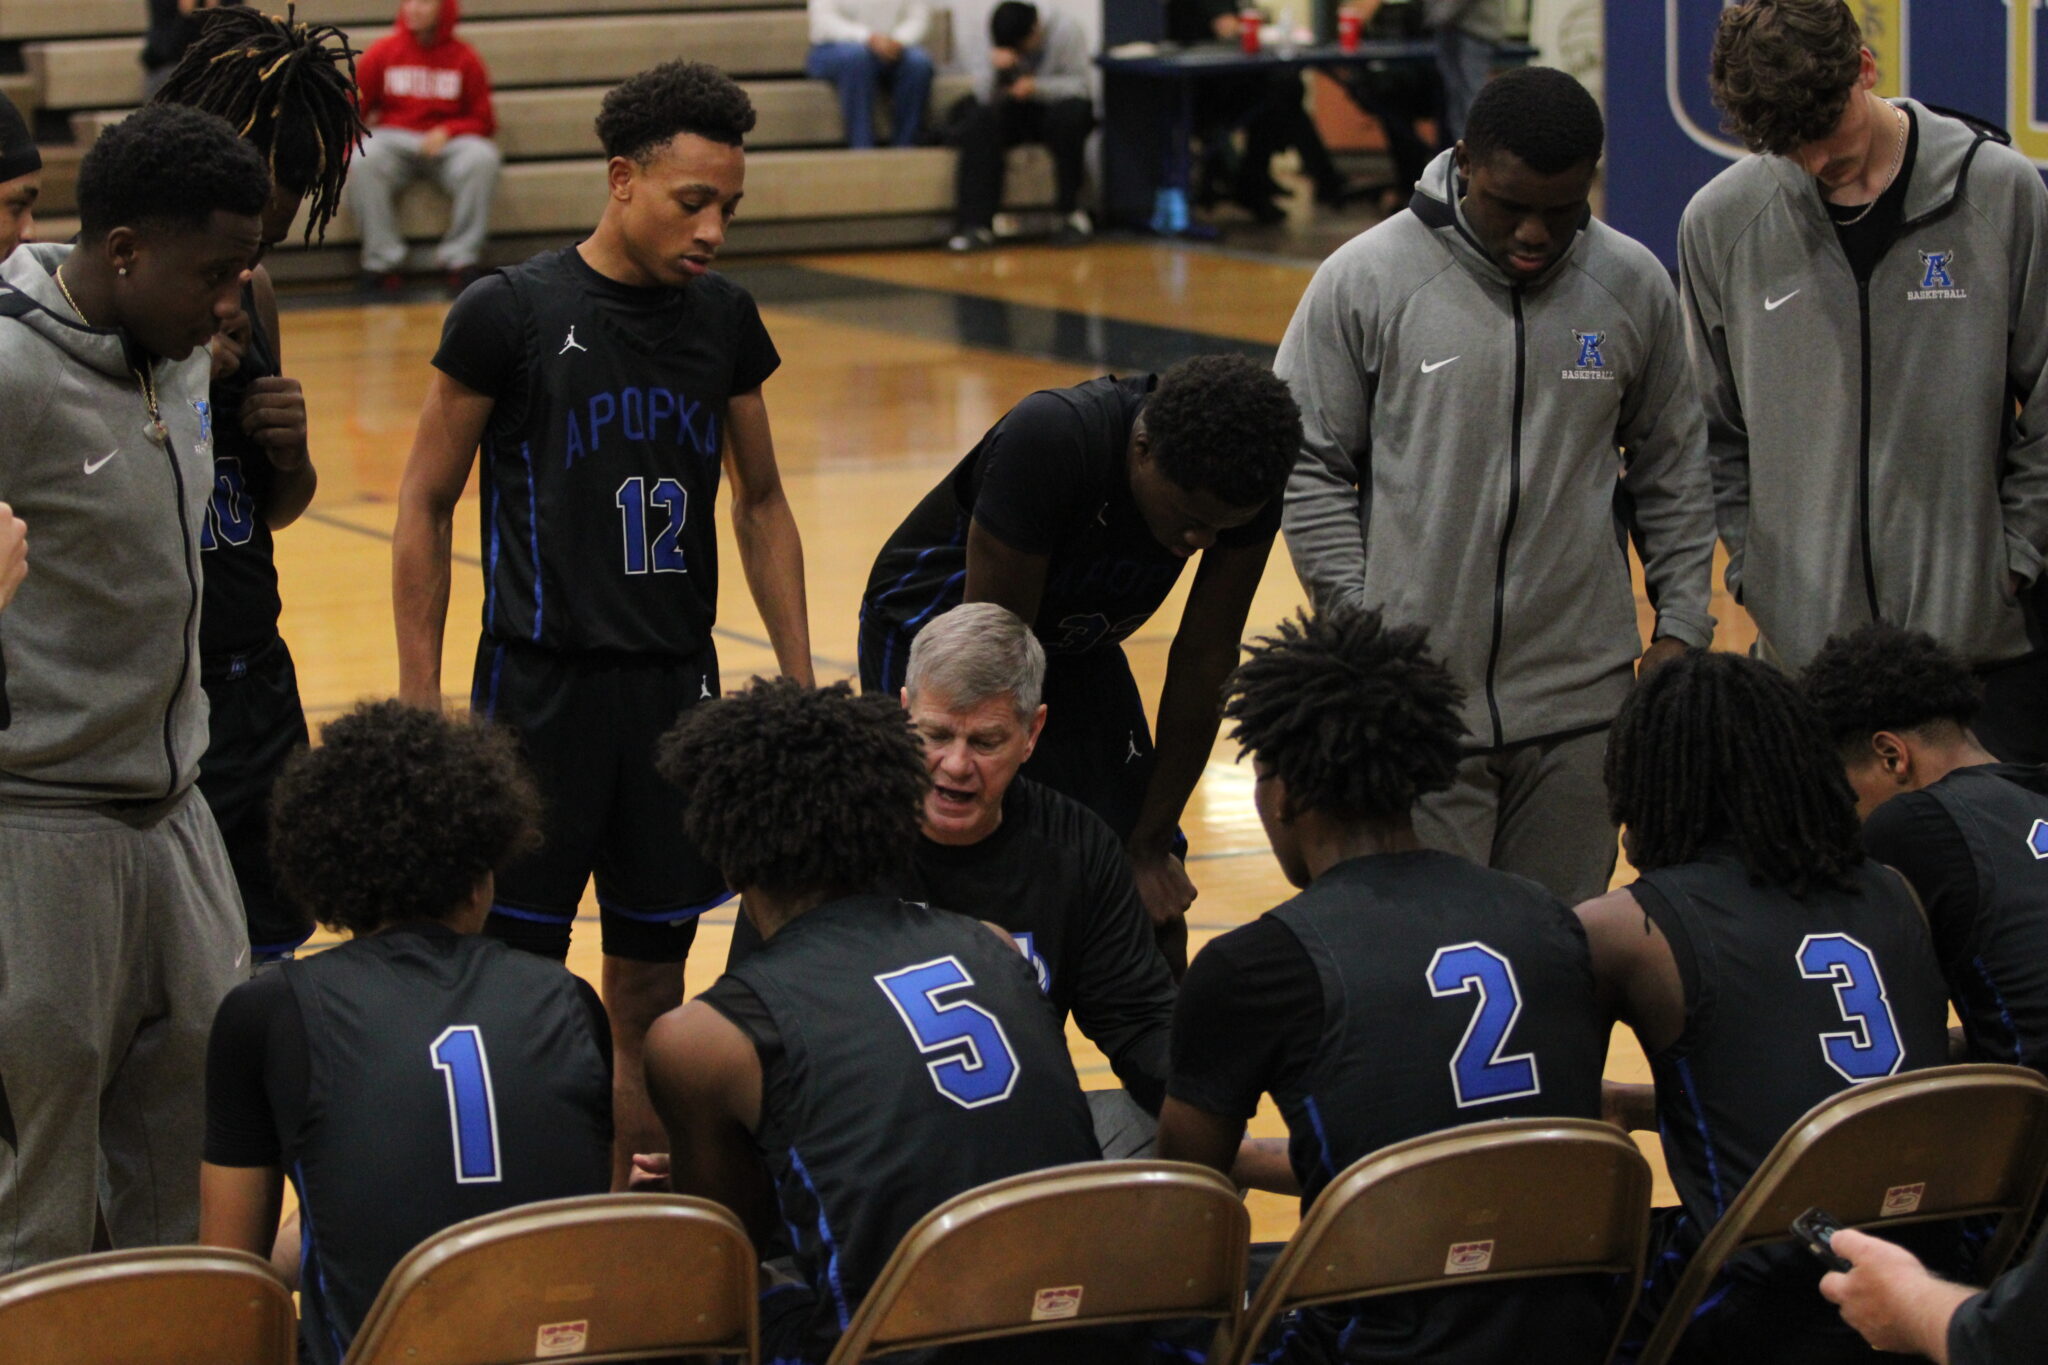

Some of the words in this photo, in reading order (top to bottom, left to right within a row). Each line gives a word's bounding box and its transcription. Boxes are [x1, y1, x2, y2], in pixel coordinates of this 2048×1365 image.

[1907, 289, 1967, 301] BASKETBALL
[565, 386, 717, 470] APOPKA
[1561, 369, 1614, 380] BASKETBALL
[615, 476, 687, 575] 12
[873, 954, 1020, 1109] 5
[1425, 941, 1541, 1108] 2
[1795, 932, 1905, 1084] 3
[429, 1025, 502, 1183] 1
